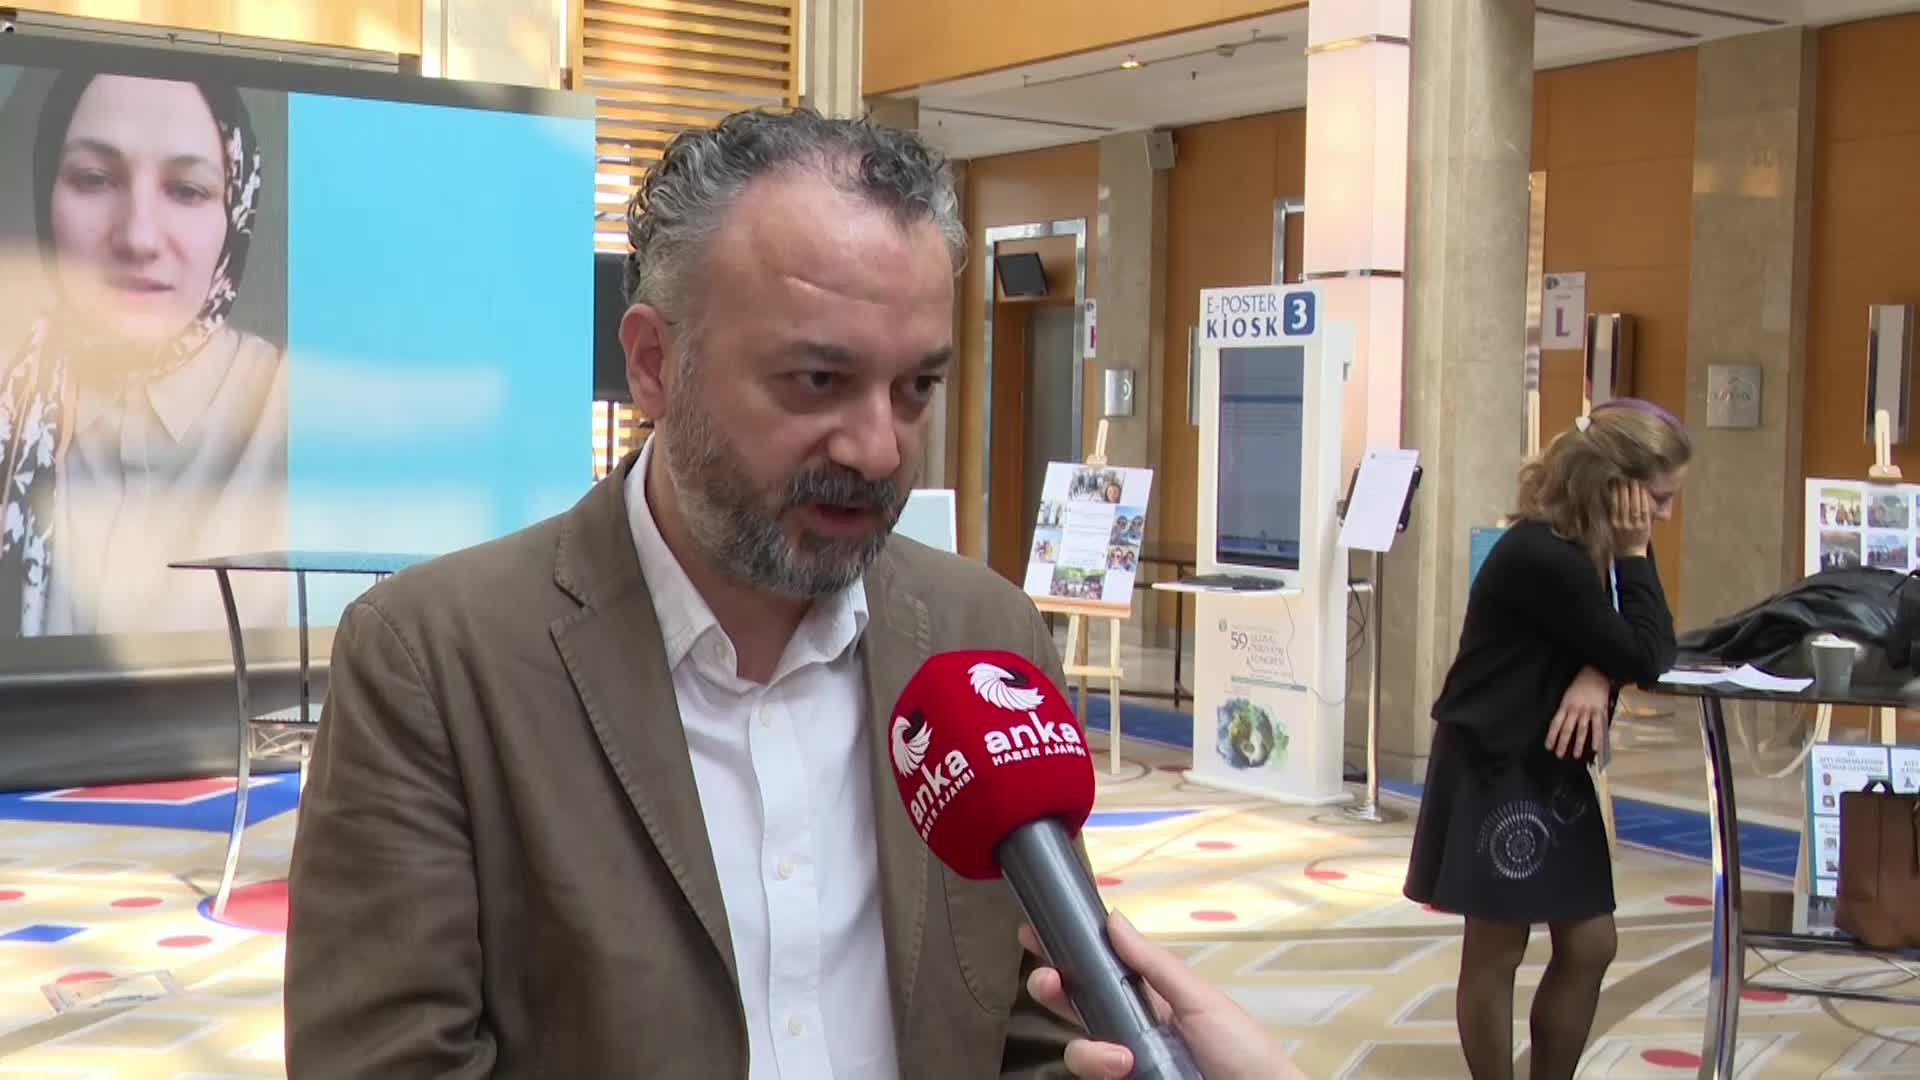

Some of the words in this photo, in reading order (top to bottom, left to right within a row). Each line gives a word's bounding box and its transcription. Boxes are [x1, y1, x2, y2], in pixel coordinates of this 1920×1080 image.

[1206, 293, 1278, 315] E-POSTER
[1290, 298, 1308, 331] 3
[1555, 307, 1570, 338] L
[983, 711, 1082, 755] anka
[991, 746, 1041, 767] HABER
[1045, 743, 1087, 757] AJANSI
[910, 749, 970, 826] anka
[938, 768, 976, 810] AJANSI
